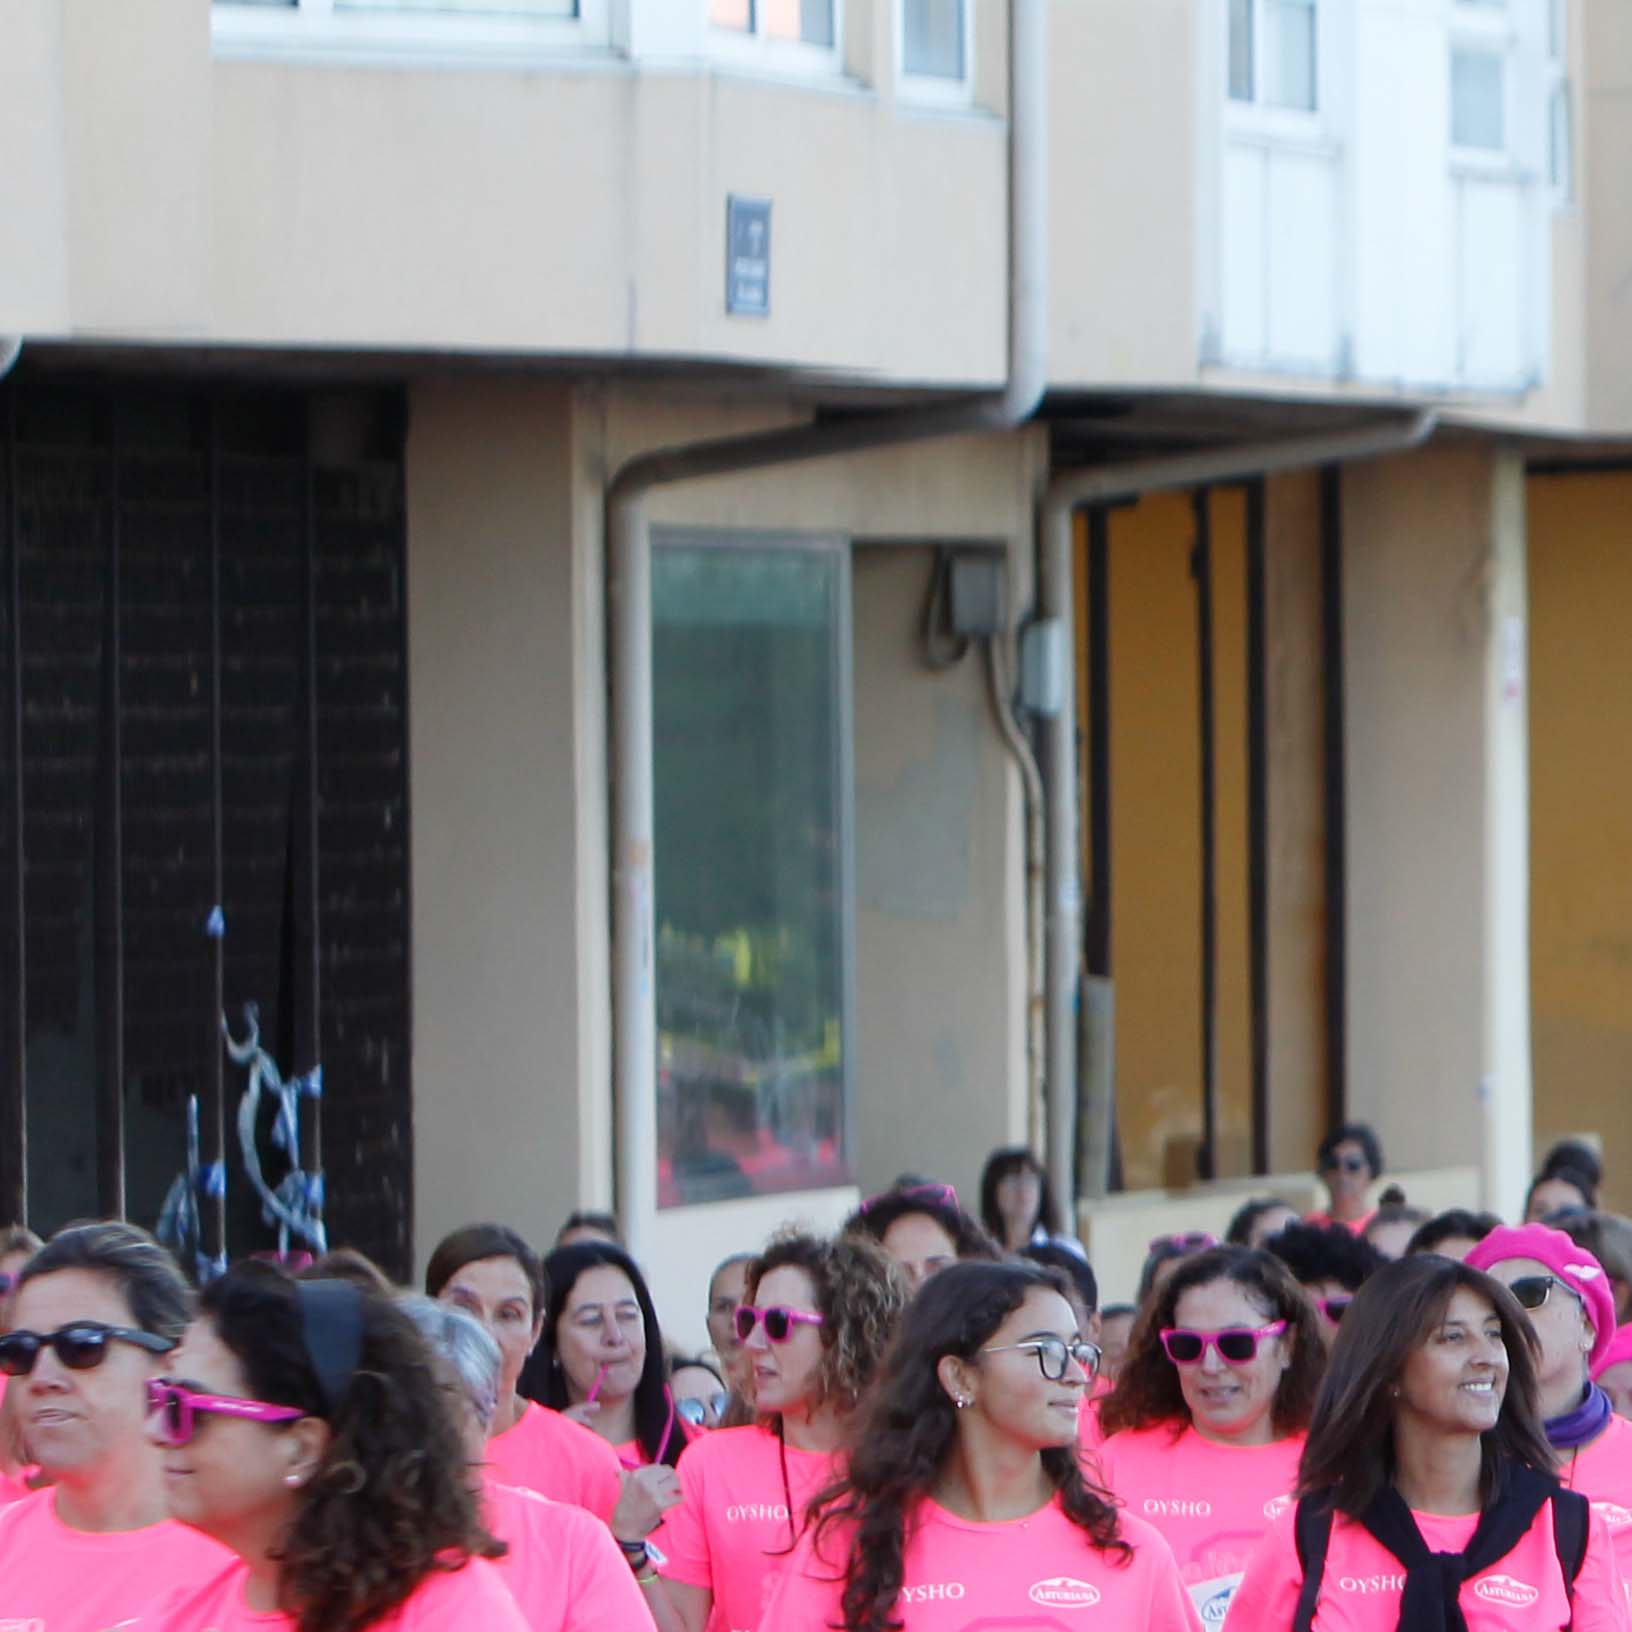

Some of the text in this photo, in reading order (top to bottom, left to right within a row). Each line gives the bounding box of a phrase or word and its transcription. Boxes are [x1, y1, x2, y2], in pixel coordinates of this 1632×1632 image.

[726, 1503, 790, 1521] OYSHO
[1143, 1498, 1211, 1517] OYSHO
[902, 1583, 965, 1603] YSHO
